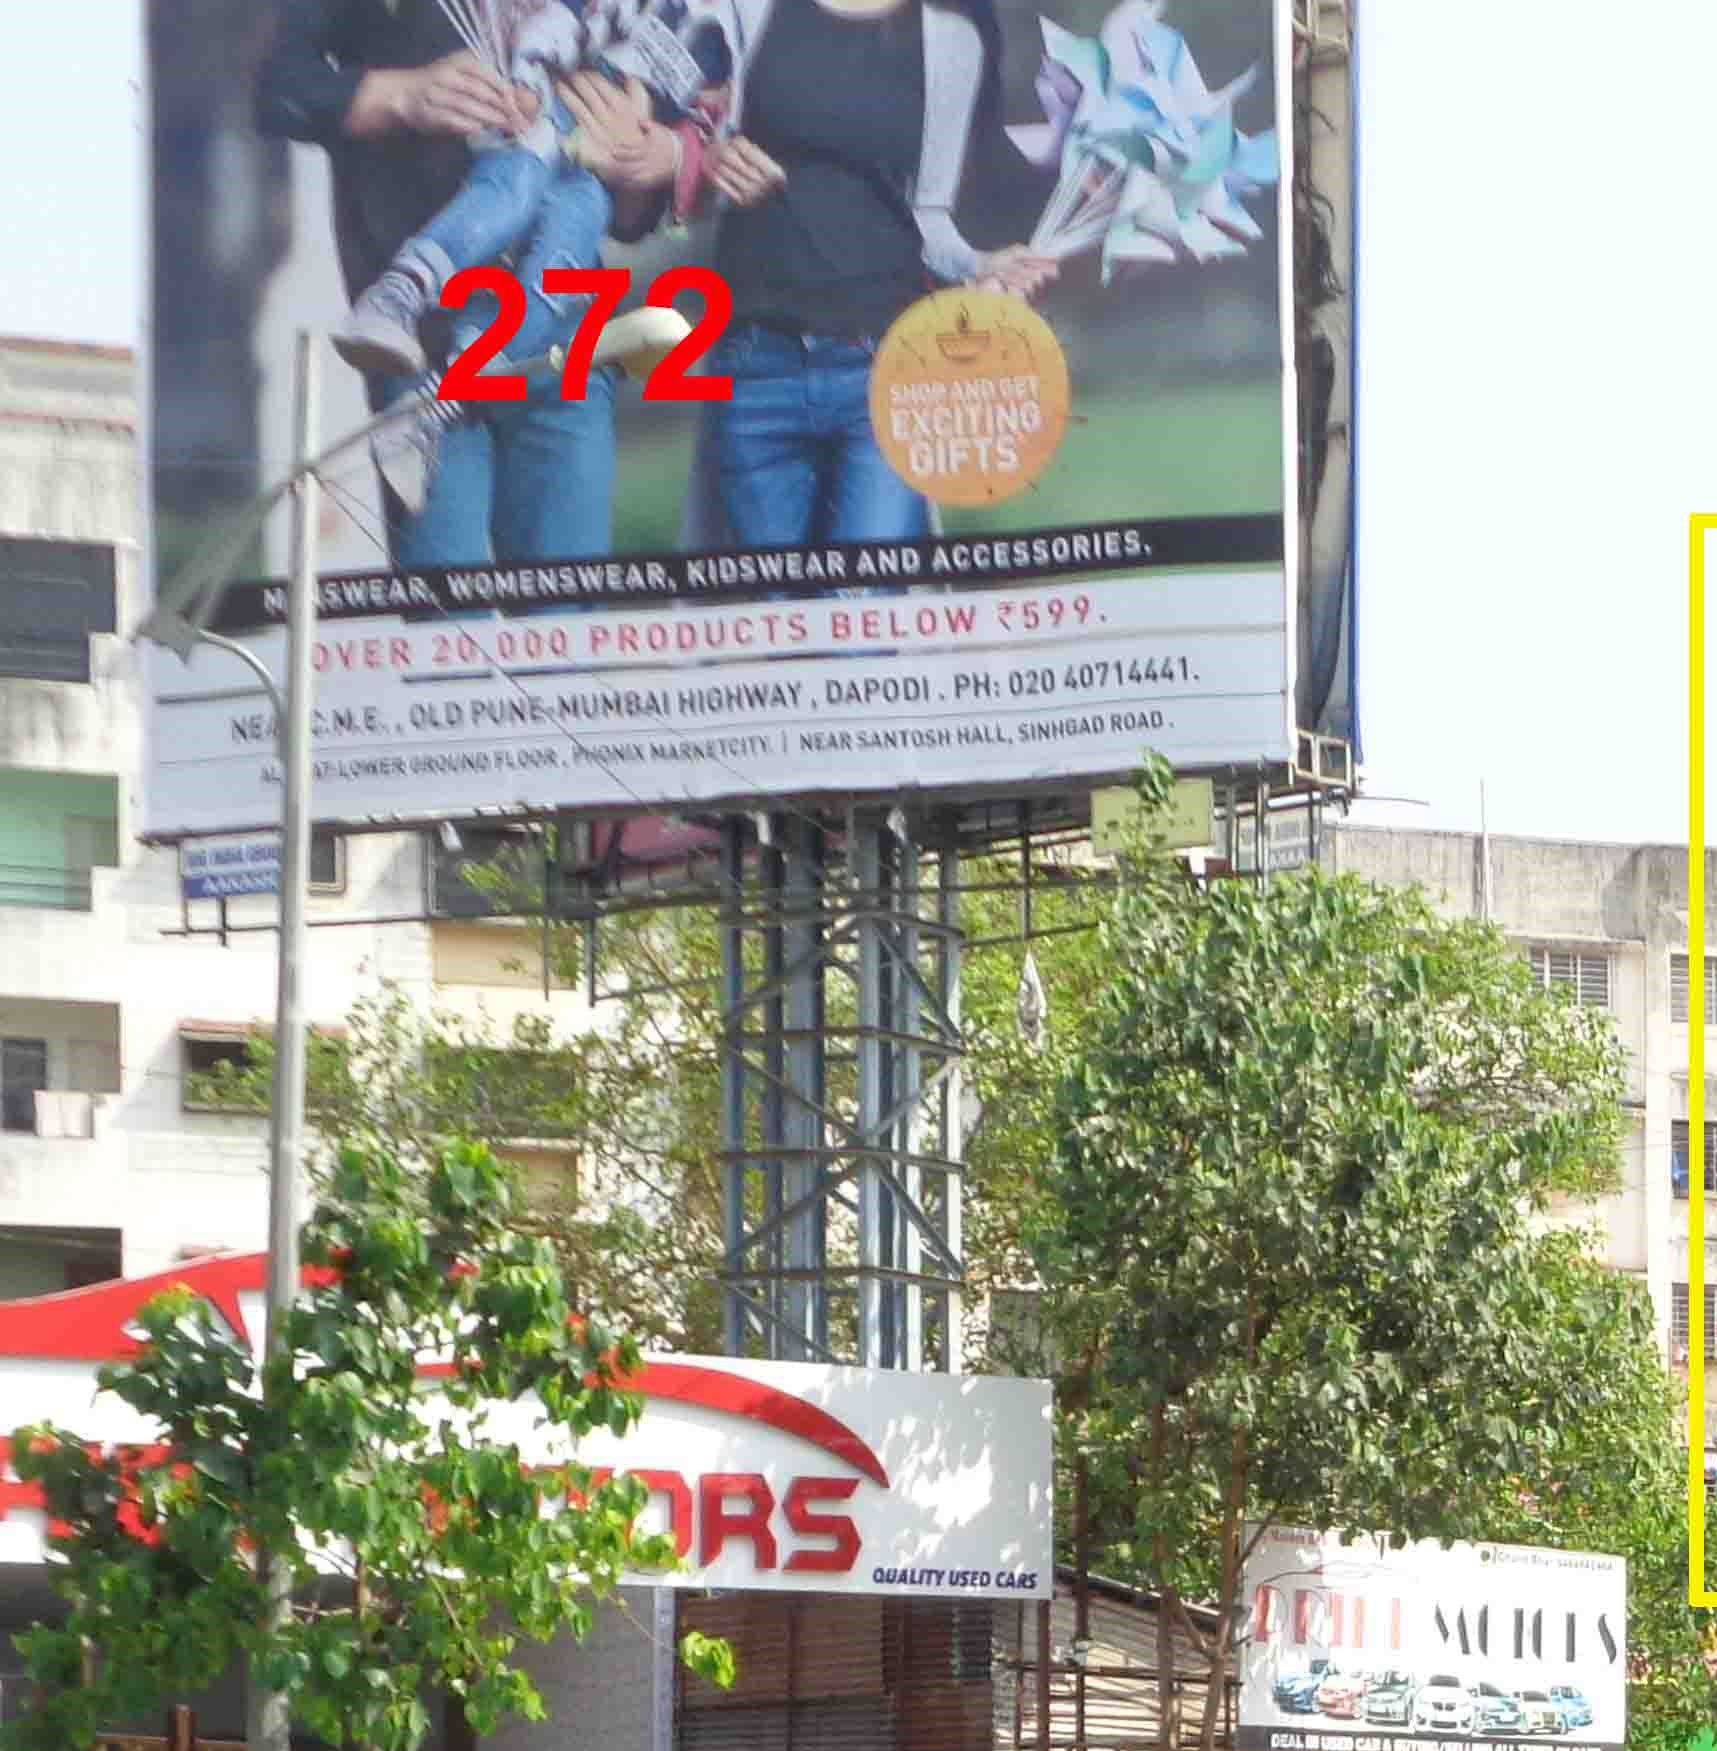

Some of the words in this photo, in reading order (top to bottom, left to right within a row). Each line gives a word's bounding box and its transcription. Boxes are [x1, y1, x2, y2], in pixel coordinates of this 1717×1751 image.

[892, 400, 1040, 440] EXCITING
[910, 436, 1019, 475] GIFTS
[446, 560, 677, 601] WOMENSWEAR,
[686, 545, 847, 589] KIDSWEAR
[857, 543, 921, 580] AND
[933, 529, 1153, 574] ACCESSORIES.
[311, 636, 411, 673] OVER
[590, 614, 808, 655] PRODUCTS
[830, 606, 977, 642] BELOW
[409, 701, 463, 730] OLD
[470, 689, 671, 727] PUNE-MUMBAI
[954, 671, 1002, 701] PH:
[1008, 667, 1056, 698] 020
[1063, 655, 1201, 691] 40714441.
[410, 751, 490, 775] GROUND
[799, 731, 854, 754] NEAR
[857, 726, 951, 751] SANTOSH
[958, 723, 1013, 748] HALL,
[1018, 716, 1104, 744] SINHGAD
[872, 1567, 945, 1586] QUALITY
[949, 1569, 991, 1588] USED
[995, 1571, 1037, 1589] CARS
[1270, 1732, 1304, 1749] DEAL
[1355, 1736, 1382, 1751] CAR
